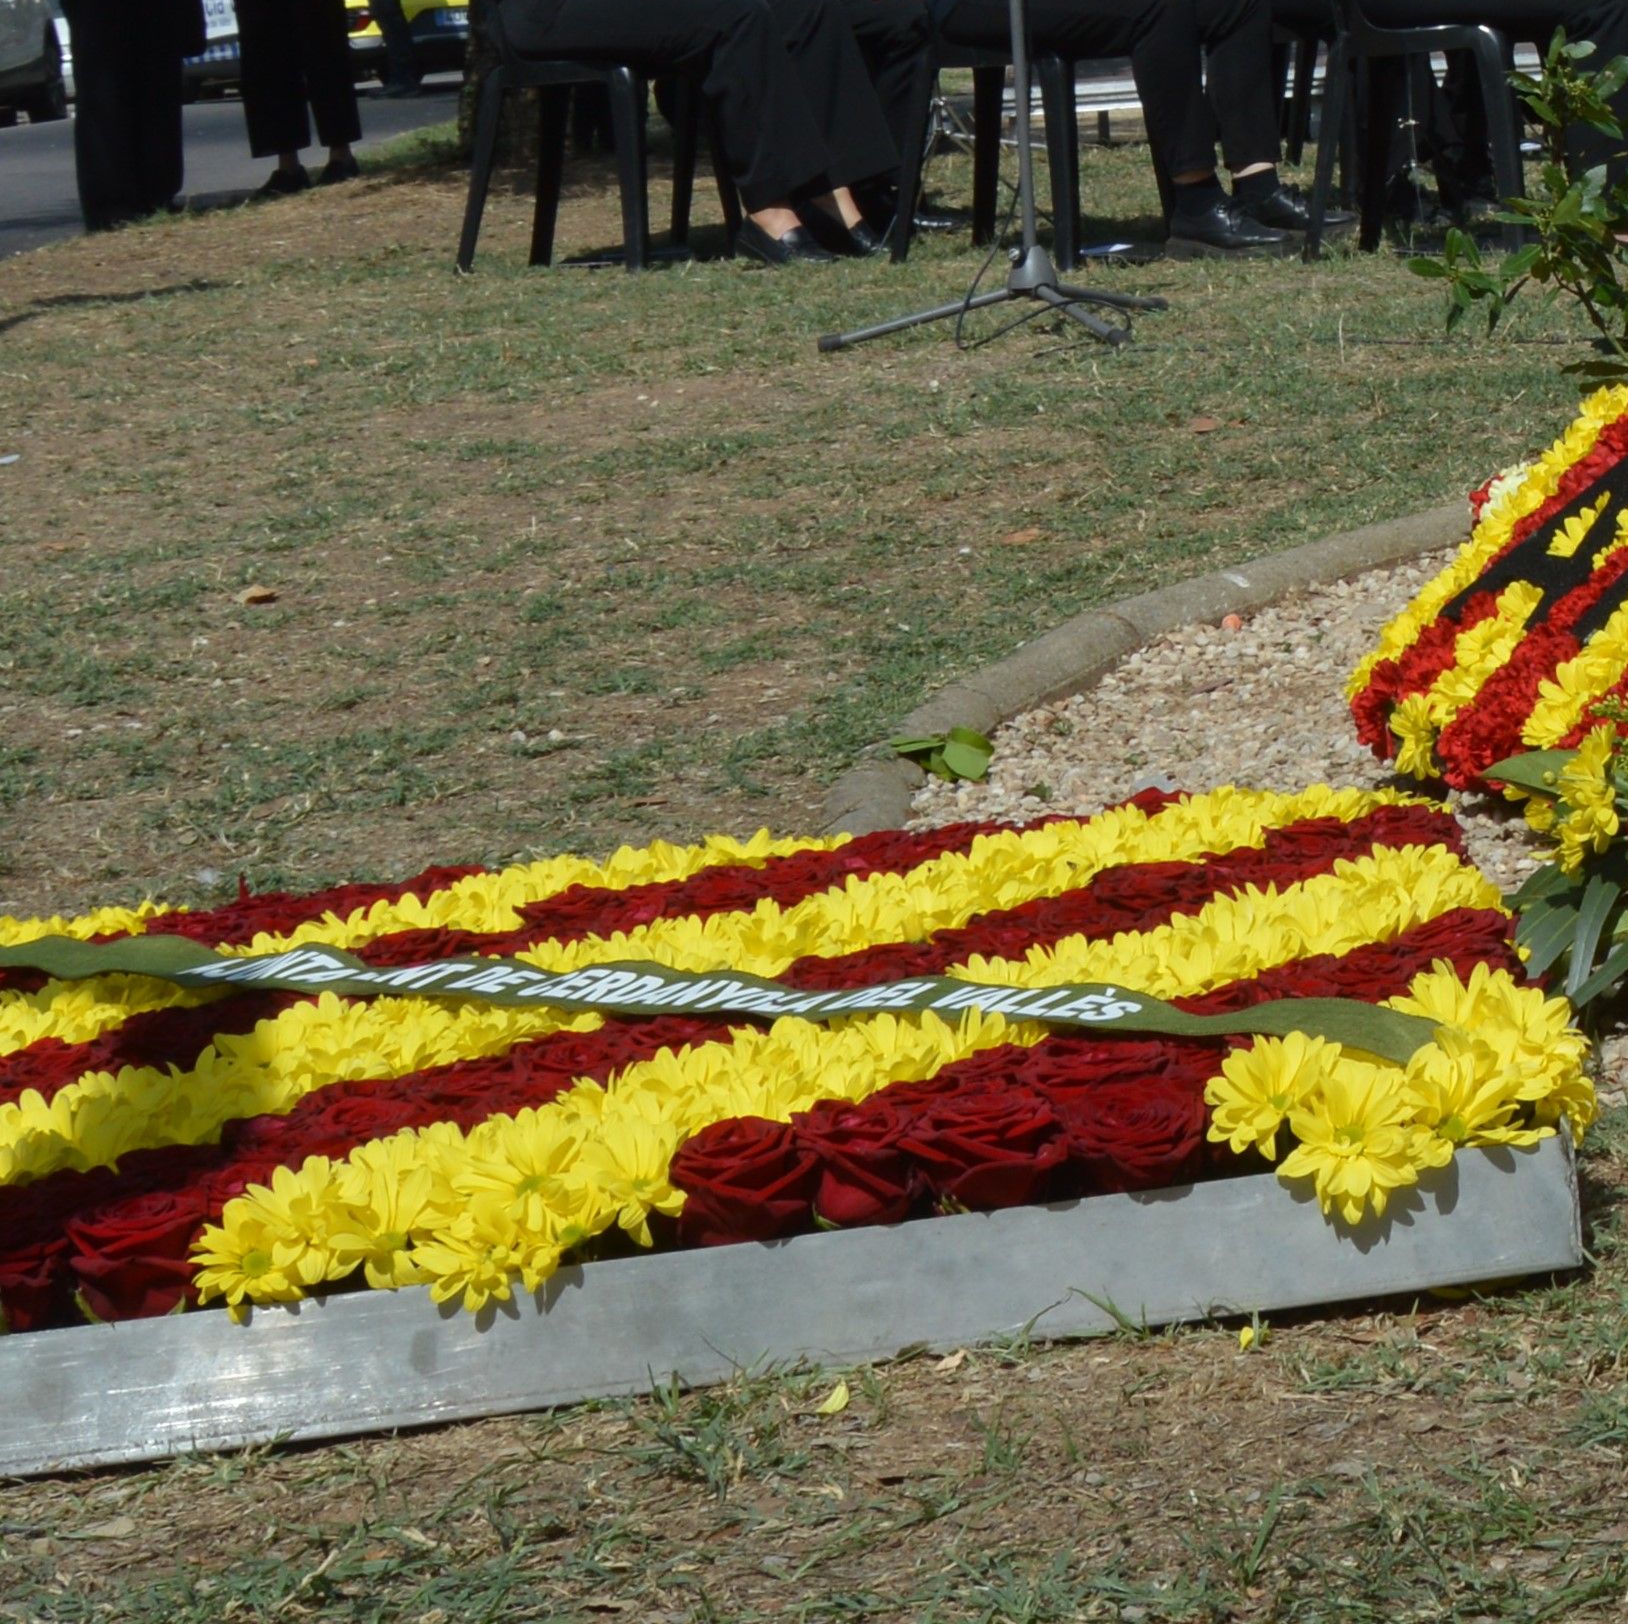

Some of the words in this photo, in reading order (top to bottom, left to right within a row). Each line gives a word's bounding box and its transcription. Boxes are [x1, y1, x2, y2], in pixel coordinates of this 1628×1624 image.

[445, 964, 526, 994] DE
[516, 968, 806, 1013] CERDANYOLA
[820, 981, 938, 1012] DEL
